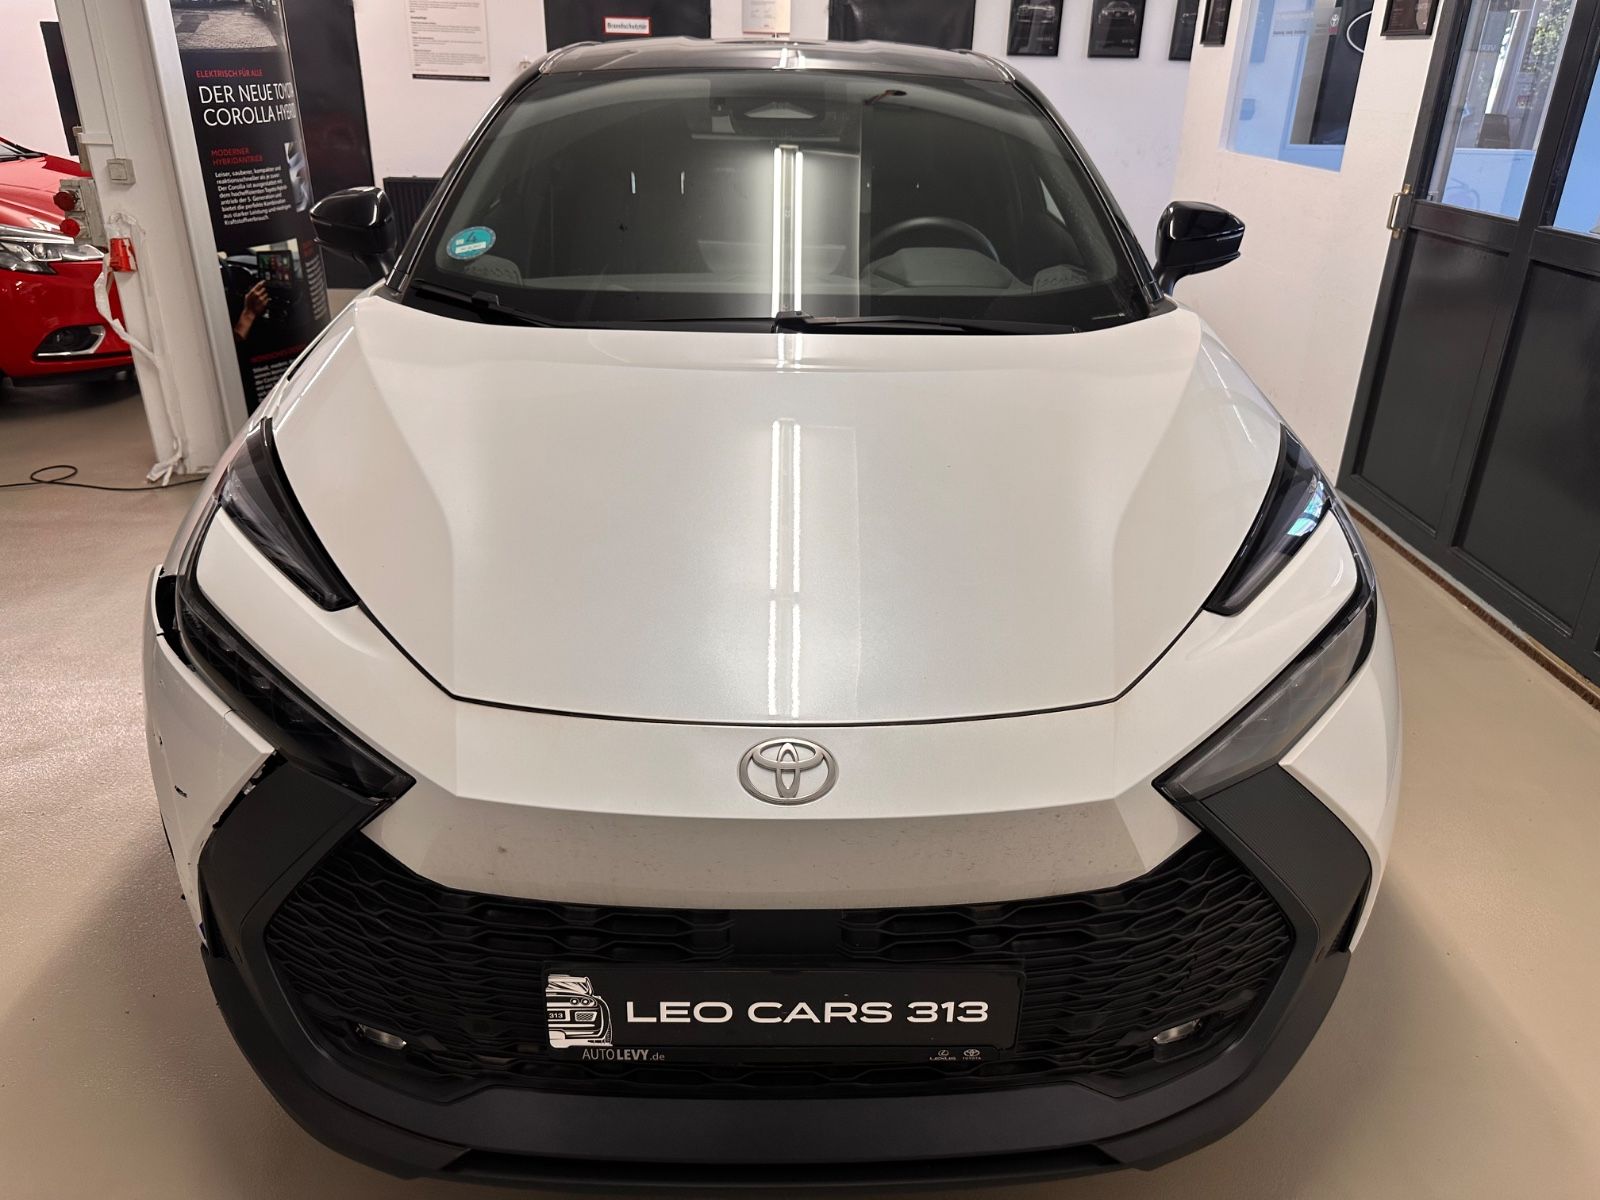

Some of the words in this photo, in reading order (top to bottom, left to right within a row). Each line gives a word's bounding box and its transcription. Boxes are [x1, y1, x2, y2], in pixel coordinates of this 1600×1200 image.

[196, 70, 238, 78] ELEKTRISCH
[238, 68, 250, 77] FÜR
[251, 69, 263, 77] ALLE
[198, 85, 235, 104] DER
[238, 83, 273, 102] NEUE
[203, 105, 276, 126] COROLLA
[211, 148, 249, 156] MODERNER
[626, 1001, 733, 1024] LEO
[747, 1001, 893, 1024] CARS
[906, 1001, 988, 1023] 313
